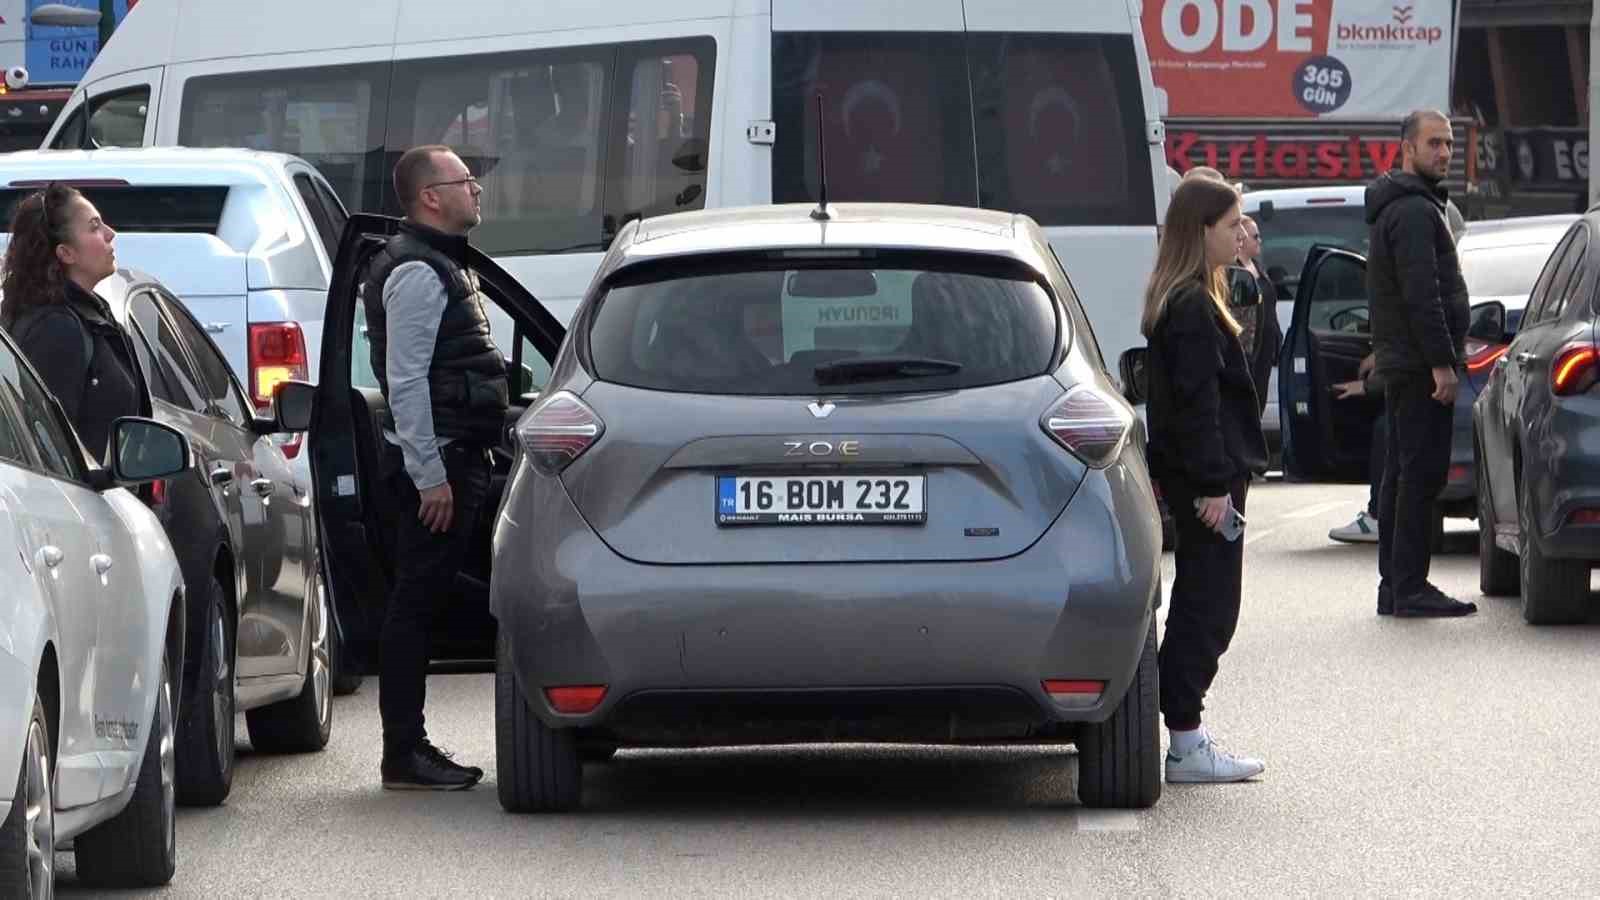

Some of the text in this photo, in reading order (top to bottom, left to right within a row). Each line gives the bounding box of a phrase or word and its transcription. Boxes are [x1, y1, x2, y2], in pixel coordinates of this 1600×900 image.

[1336, 24, 1442, 44] bkmkitap
[1303, 64, 1344, 87] 365
[1303, 86, 1337, 105] GÜN
[783, 440, 860, 456] ZOE
[722, 498, 735, 507] TR
[740, 480, 910, 510] 16 BOM 232
[778, 513, 865, 521] MAIS BURSA
